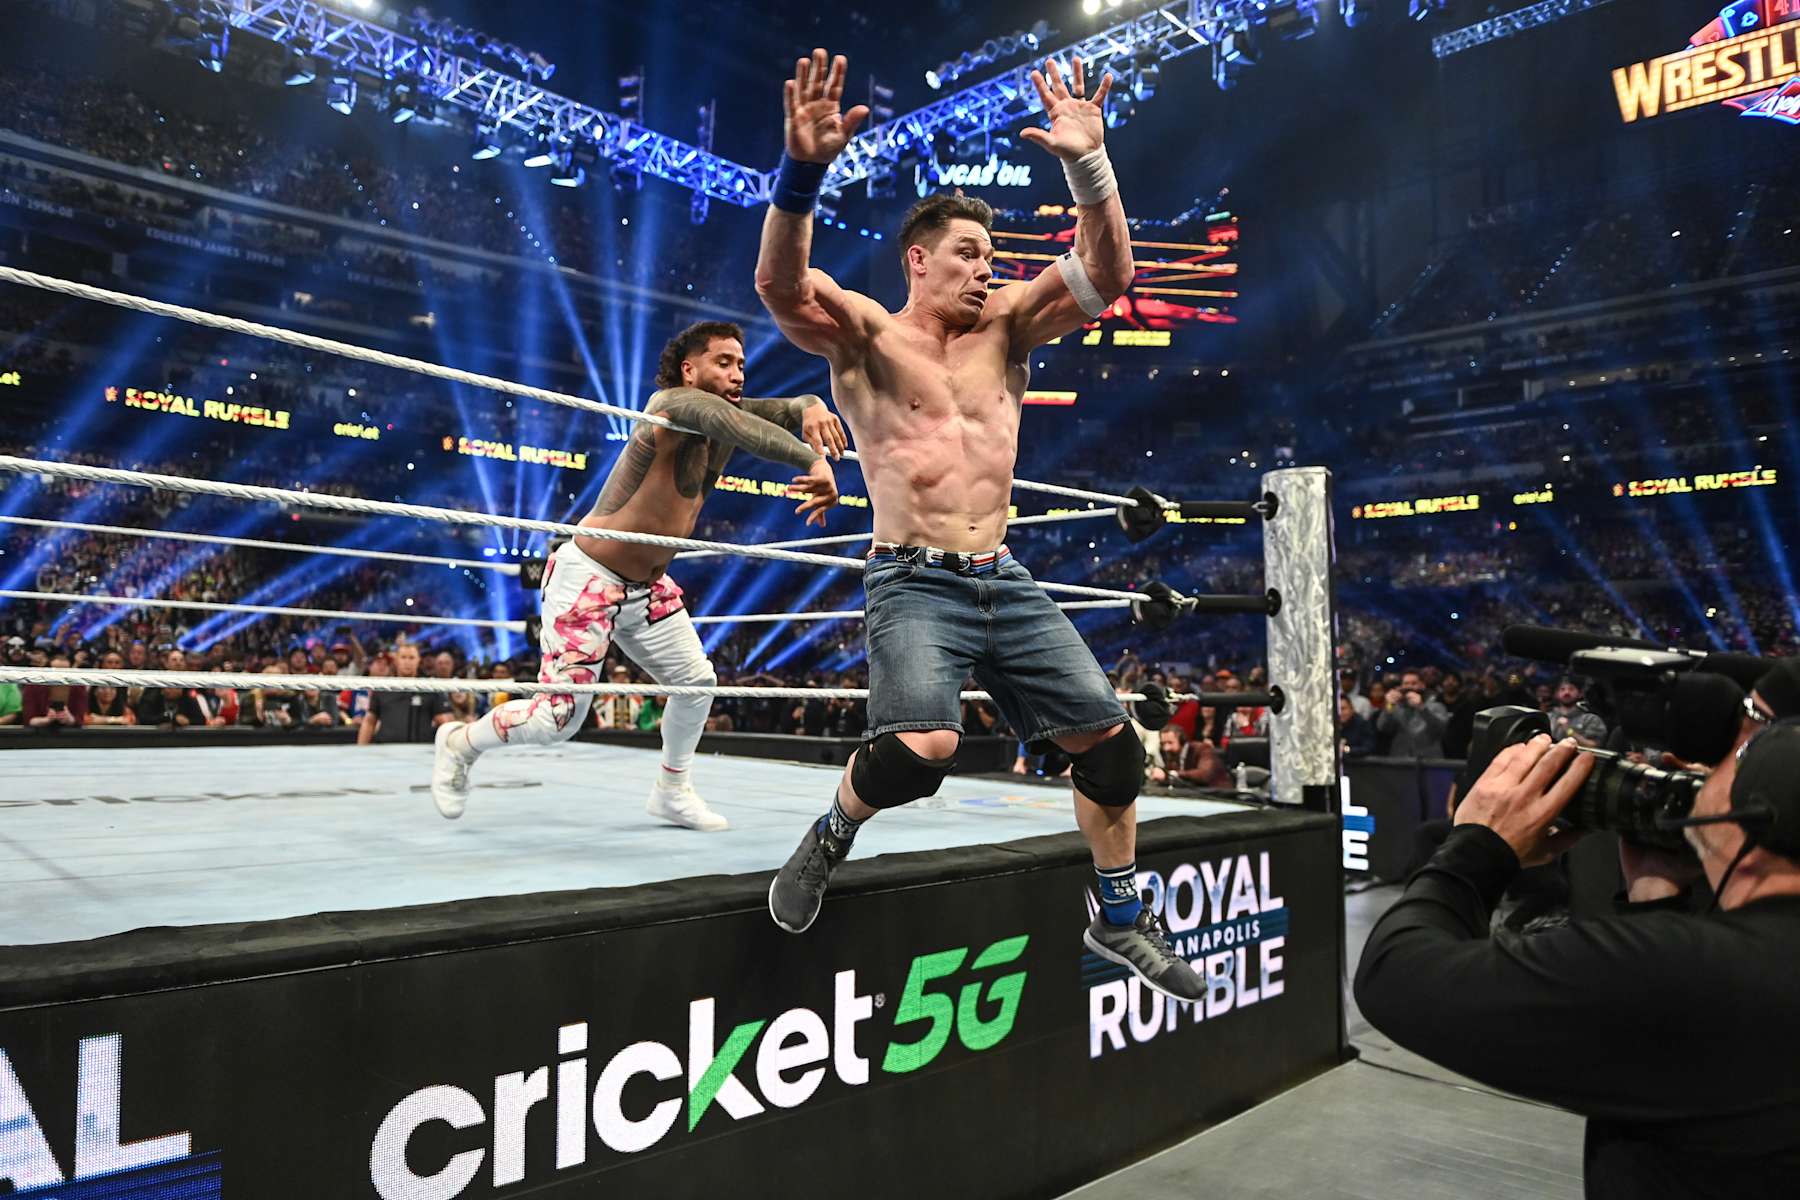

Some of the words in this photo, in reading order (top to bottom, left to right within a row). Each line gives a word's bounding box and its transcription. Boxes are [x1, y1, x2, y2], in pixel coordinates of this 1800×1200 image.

[1612, 28, 1800, 124] WRESTL
[997, 163, 1032, 187] OIL
[125, 387, 200, 417] ROYAL
[203, 400, 291, 430] RUMBLE
[458, 436, 518, 462] ROYAL
[518, 445, 587, 471] RUMBLE
[714, 475, 761, 495] ROYAL
[1628, 477, 1693, 497] ROYAL
[1694, 469, 1777, 491] RUMBLE
[1363, 501, 1415, 519] ROYAL
[1415, 494, 1480, 514] RUMBLE
[1174, 919, 1261, 957] ANAPOLIS
[881, 934, 1030, 1074] 5G
